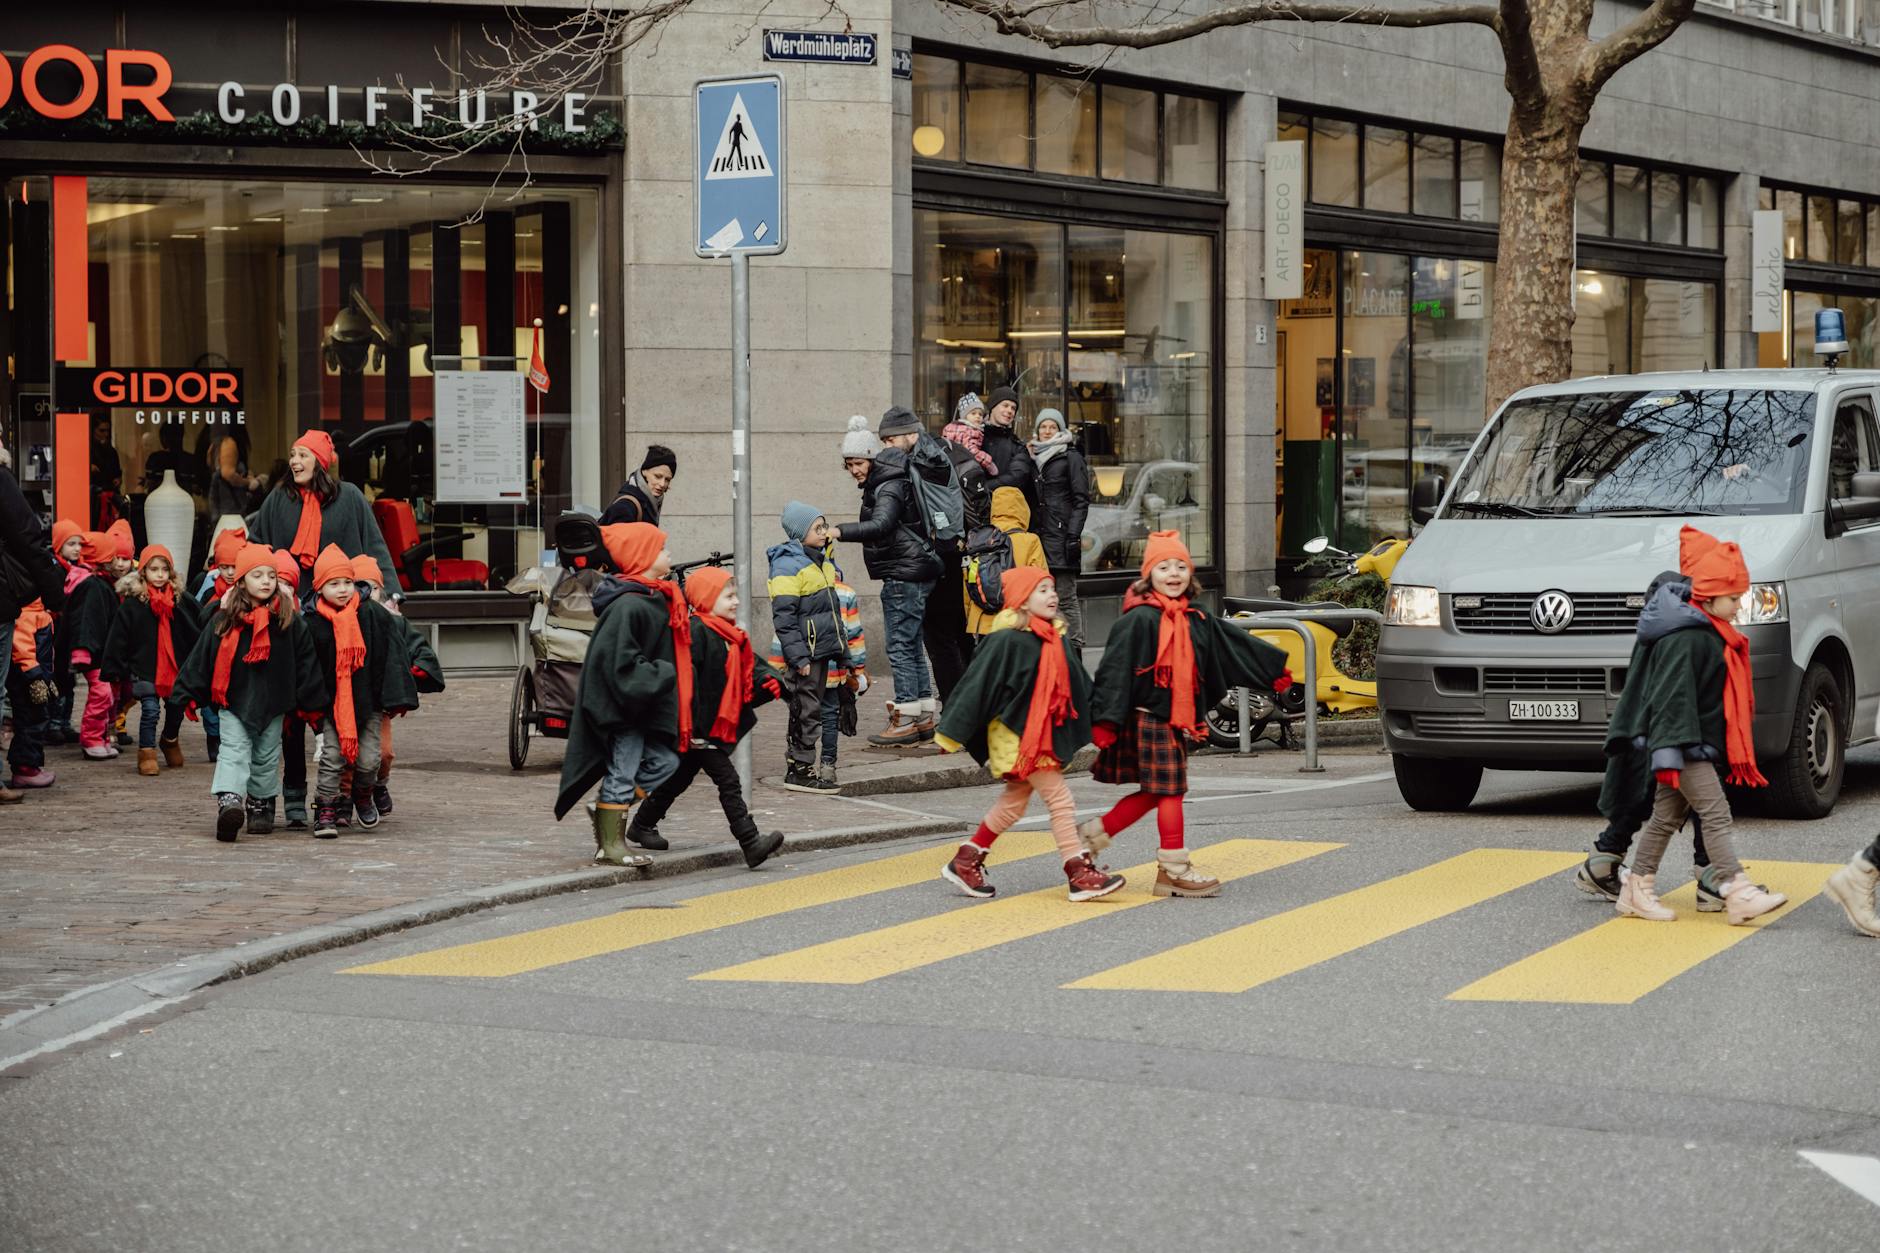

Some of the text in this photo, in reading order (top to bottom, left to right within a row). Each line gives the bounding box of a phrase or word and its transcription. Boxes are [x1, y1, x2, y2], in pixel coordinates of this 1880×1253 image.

[769, 33, 872, 60] Werdmühleplatz
[0, 44, 588, 133] OR COIFFURE
[1276, 182, 1290, 282] ART-DECO
[92, 371, 239, 404] GIDOR
[135, 410, 246, 425] COIFFURE
